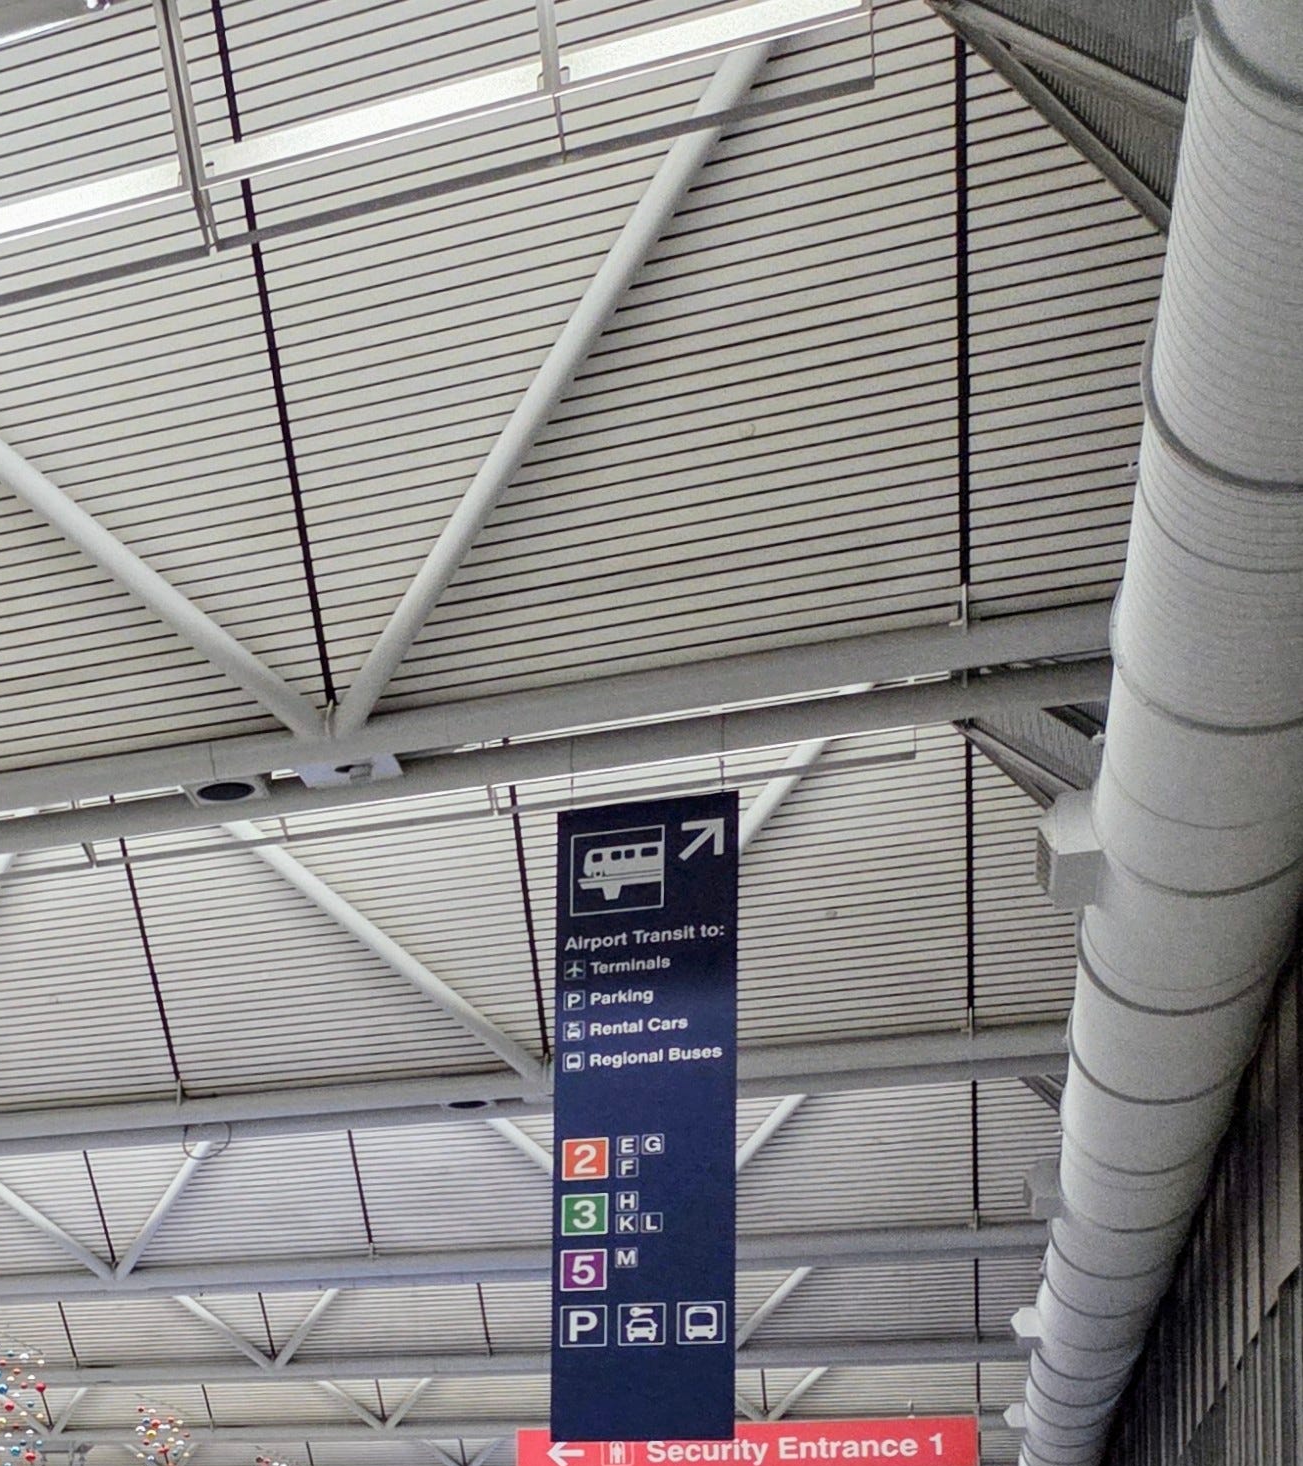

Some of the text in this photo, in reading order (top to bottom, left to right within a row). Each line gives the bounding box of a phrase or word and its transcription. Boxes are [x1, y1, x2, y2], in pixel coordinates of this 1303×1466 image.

[564, 924, 725, 952] Airport Transit to:
[590, 956, 671, 974] Terminals
[590, 989, 654, 1006] Parking
[590, 1017, 688, 1037] Rental Cars
[589, 1046, 723, 1068] Regional Buses
[573, 1136, 662, 1174] 2 E G
[621, 1161, 634, 1175] F
[572, 1194, 635, 1230] 3 H
[619, 1216, 658, 1231] K L
[571, 1251, 636, 1285] 5 M
[569, 1311, 598, 1342] P
[646, 1433, 943, 1466] Security Entrance 1
